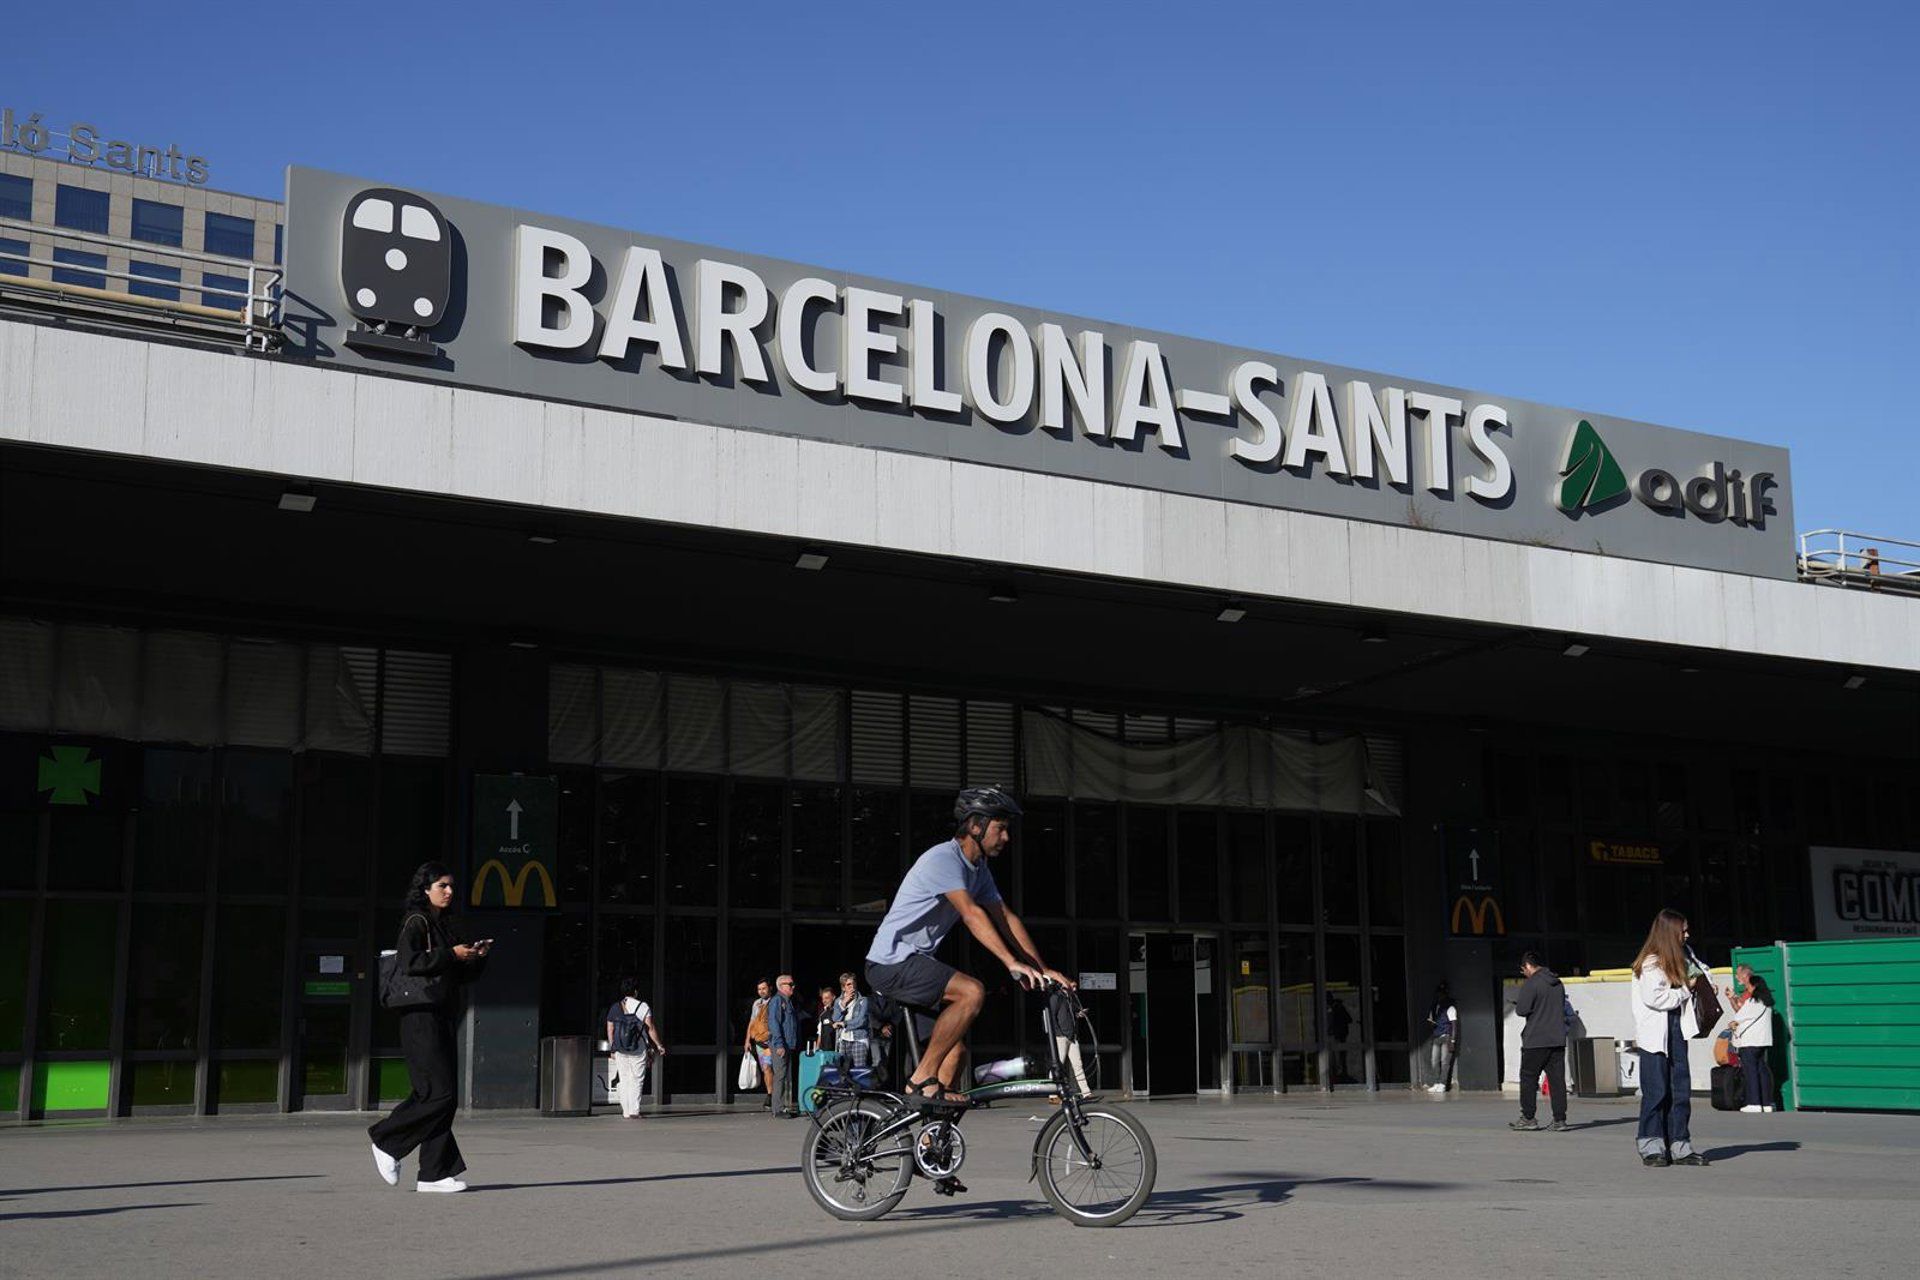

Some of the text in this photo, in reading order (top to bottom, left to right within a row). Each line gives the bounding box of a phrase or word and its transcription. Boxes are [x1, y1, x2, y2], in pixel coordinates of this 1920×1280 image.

[69, 121, 210, 185] Sants
[513, 223, 1513, 500] BARCELONA-SANTS
[1632, 460, 1776, 525] adif
